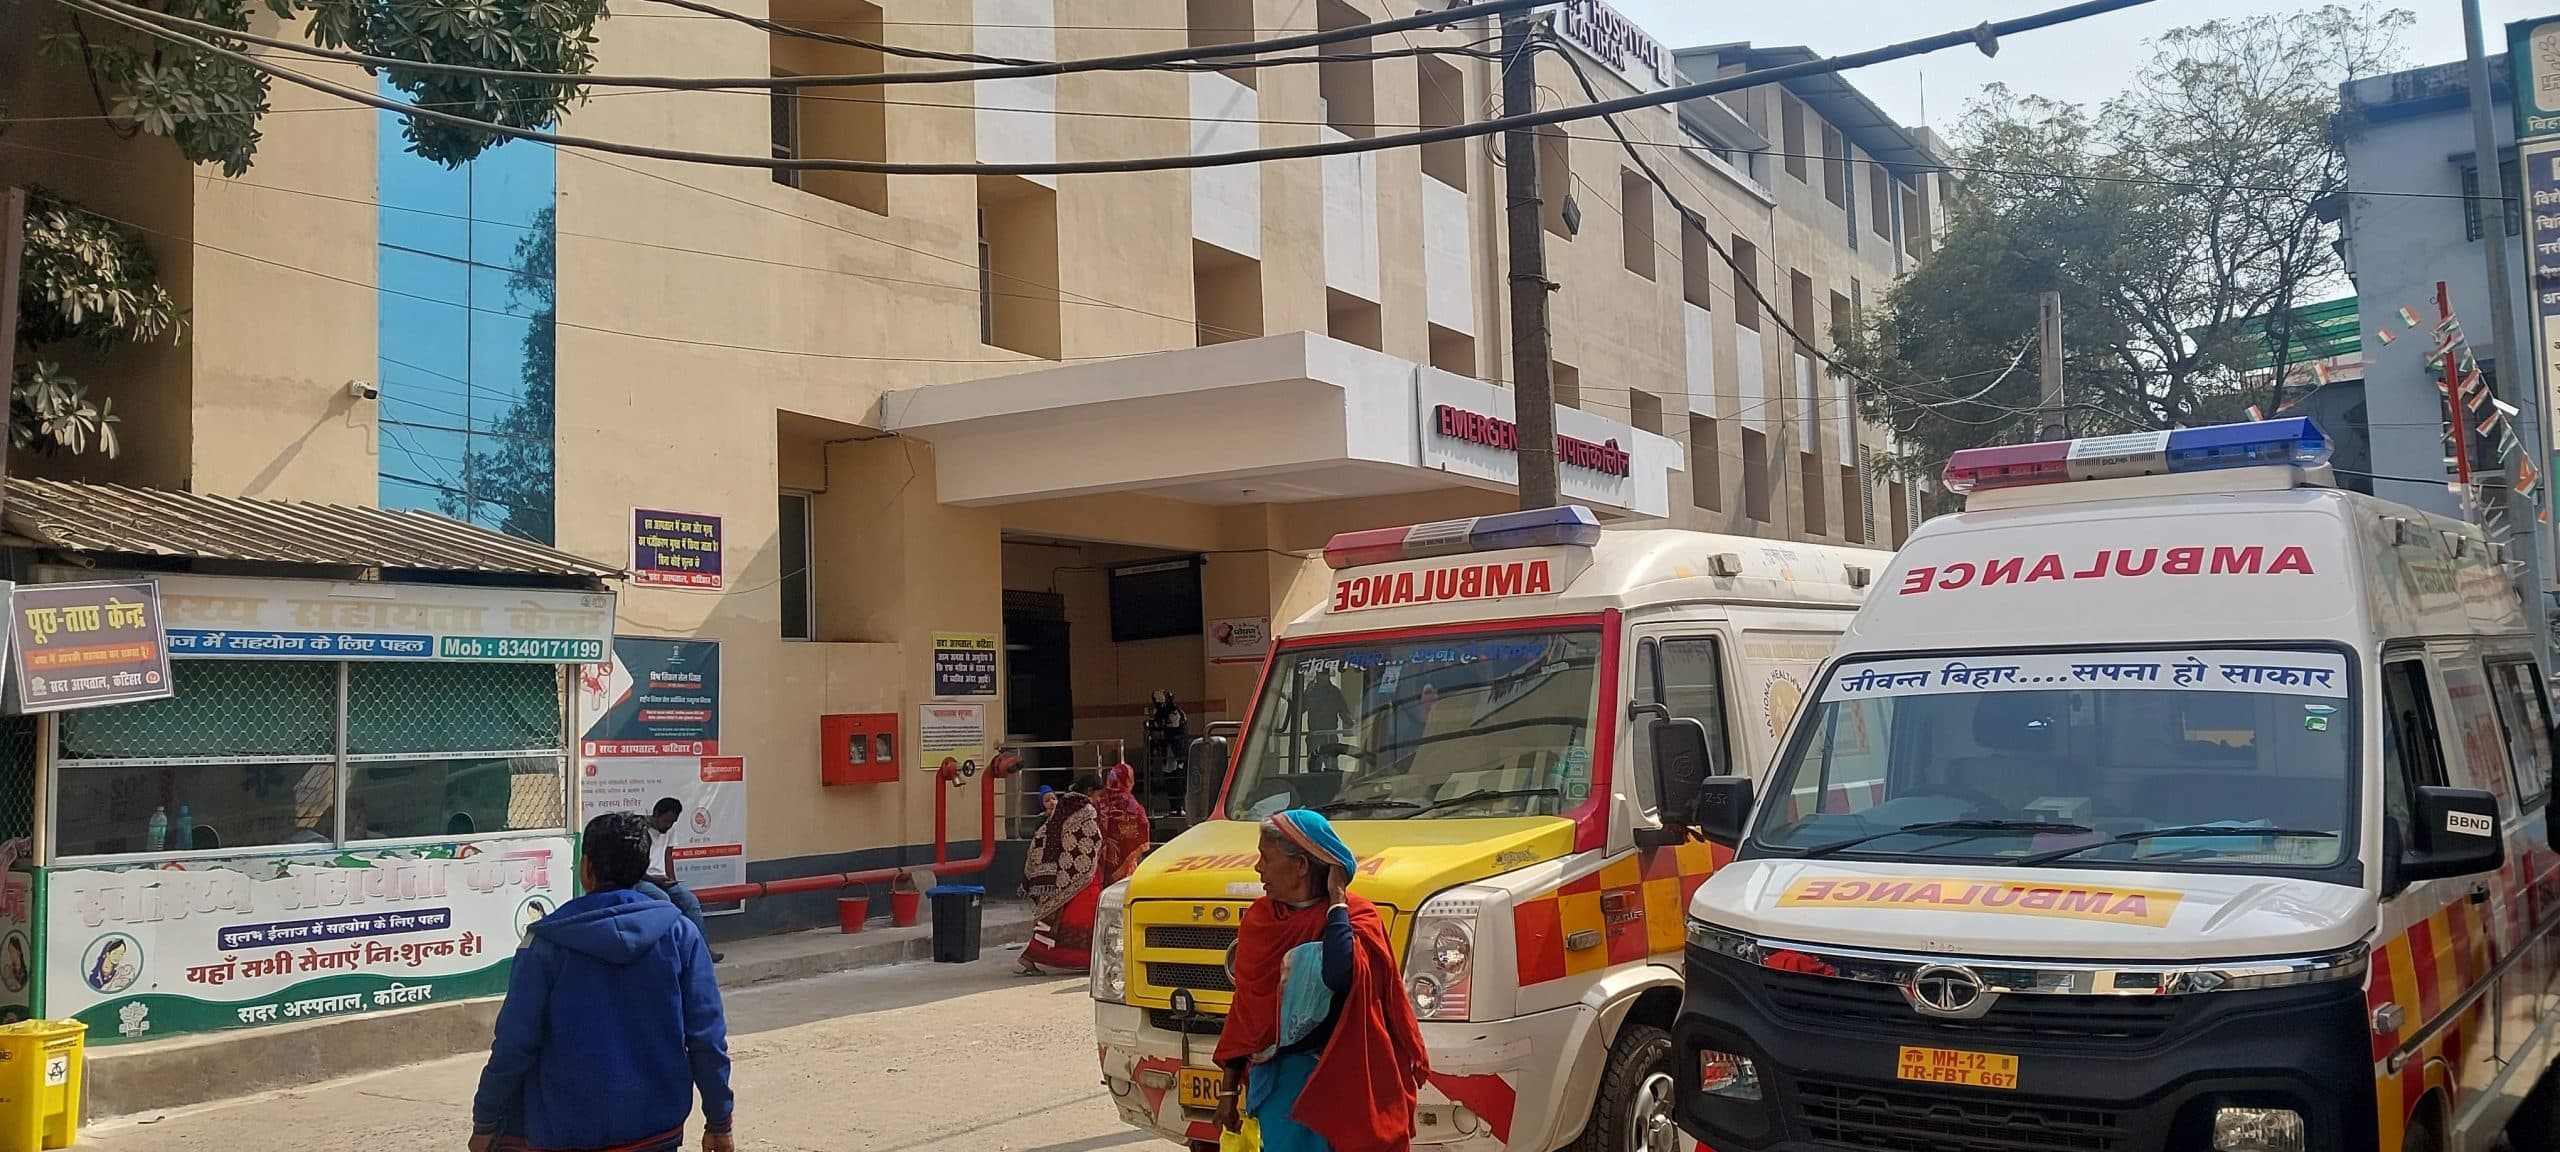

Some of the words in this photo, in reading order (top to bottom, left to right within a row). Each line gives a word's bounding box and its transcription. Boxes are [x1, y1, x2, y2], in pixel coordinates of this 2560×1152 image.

[1567, 8, 1625, 70] KATIHAR
[1593, 0, 1658, 70] HOSPITAL
[25, 604, 100, 645] पूछ-ताछ
[104, 597, 146, 630] केन्द्र
[203, 631, 226, 649] में
[229, 634, 305, 650] सहयोग
[310, 634, 332, 651] के
[337, 634, 374, 651] लिए
[380, 638, 425, 652] पहल
[444, 638, 482, 656] Mob
[498, 639, 600, 658] 8340171199
[49, 679, 68, 693] सदर
[112, 671, 142, 687] कटिहार
[1840, 668, 1932, 694] जीवन्त
[2071, 662, 2162, 685] सपना
[2171, 656, 2209, 688] हो
[2219, 664, 2336, 689] साकार
[2449, 814, 2490, 831] BBND
[224, 930, 263, 950] सुलभ
[266, 926, 308, 943] ईलाज
[311, 920, 326, 937] में
[327, 917, 370, 935] सहयोग
[374, 915, 387, 930] के
[389, 914, 415, 930] लिए
[418, 912, 445, 926] पहल
[186, 953, 236, 987] यहाँ
[241, 949, 294, 978] सभी
[299, 941, 362, 971] सेवाएँ
[459, 931, 482, 957] है।
[237, 1002, 279, 1024] सदर
[283, 992, 368, 1018] अस्पताल,
[373, 981, 433, 1007] कटिहार
[1901, 1064, 1971, 1083] TR-FBT
[1980, 1071, 2016, 1087] 667
[1932, 1050, 1986, 1070] MH-12
